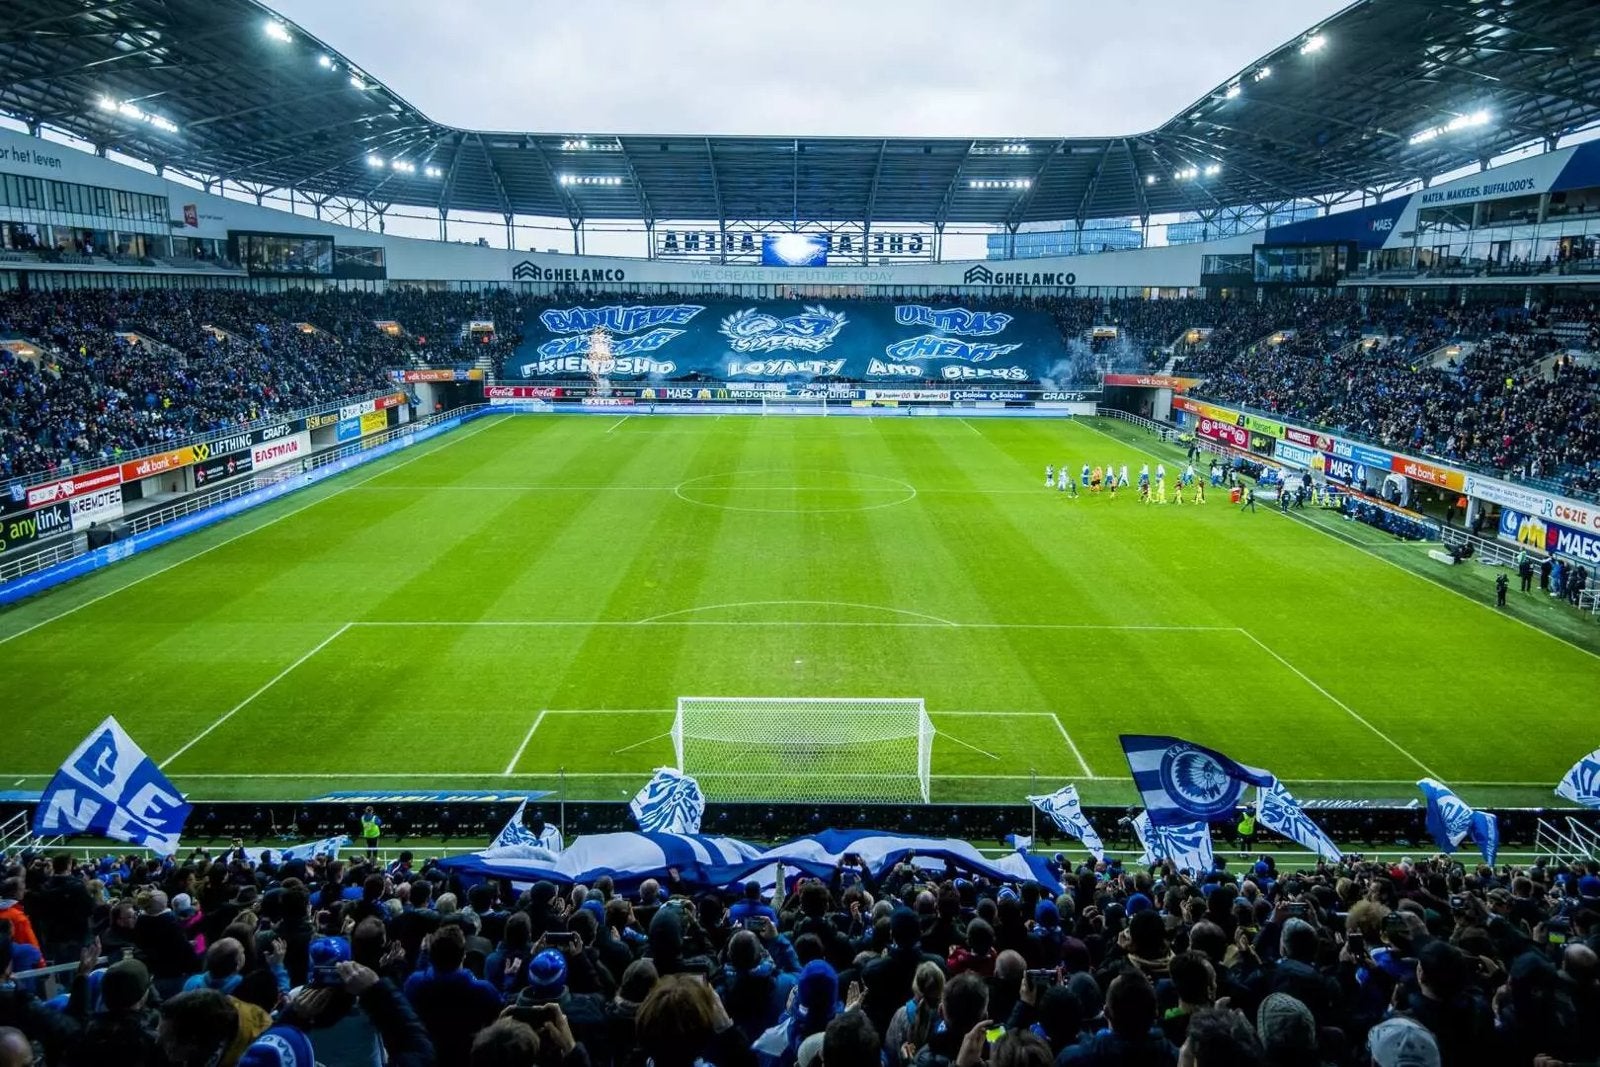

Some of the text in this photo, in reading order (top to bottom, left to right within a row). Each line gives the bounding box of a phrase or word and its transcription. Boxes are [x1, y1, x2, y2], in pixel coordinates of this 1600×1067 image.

[12, 146, 30, 163] het
[33, 150, 62, 168] leven
[1422, 193, 1445, 204] MATEN.
[1447, 187, 1481, 200] MAKKERS.
[1373, 218, 1393, 231] MAES
[544, 268, 625, 281] GHELAMCO
[692, 270, 894, 281] WE CREATE THE FUTURE TODAY
[995, 272, 1076, 285] GHELAMCO
[895, 305, 1014, 336] ULTRAS
[728, 359, 847, 377] LOYALTY
[867, 357, 923, 376] AND
[421, 372, 438, 380] bank
[666, 389, 693, 398] MAES
[815, 390, 859, 399] HYUNDAI
[1042, 392, 1077, 400] CRAFT
[263, 425, 286, 440] CRAFT
[210, 433, 253, 456] LIFTHING
[255, 440, 298, 463] EASTMAN
[136, 456, 171, 475] vdk bank
[1330, 458, 1353, 480] MAES
[1404, 463, 1436, 481] vdk bank
[1555, 505, 1588, 525] COZIE
[1557, 529, 1600, 563] MAES
